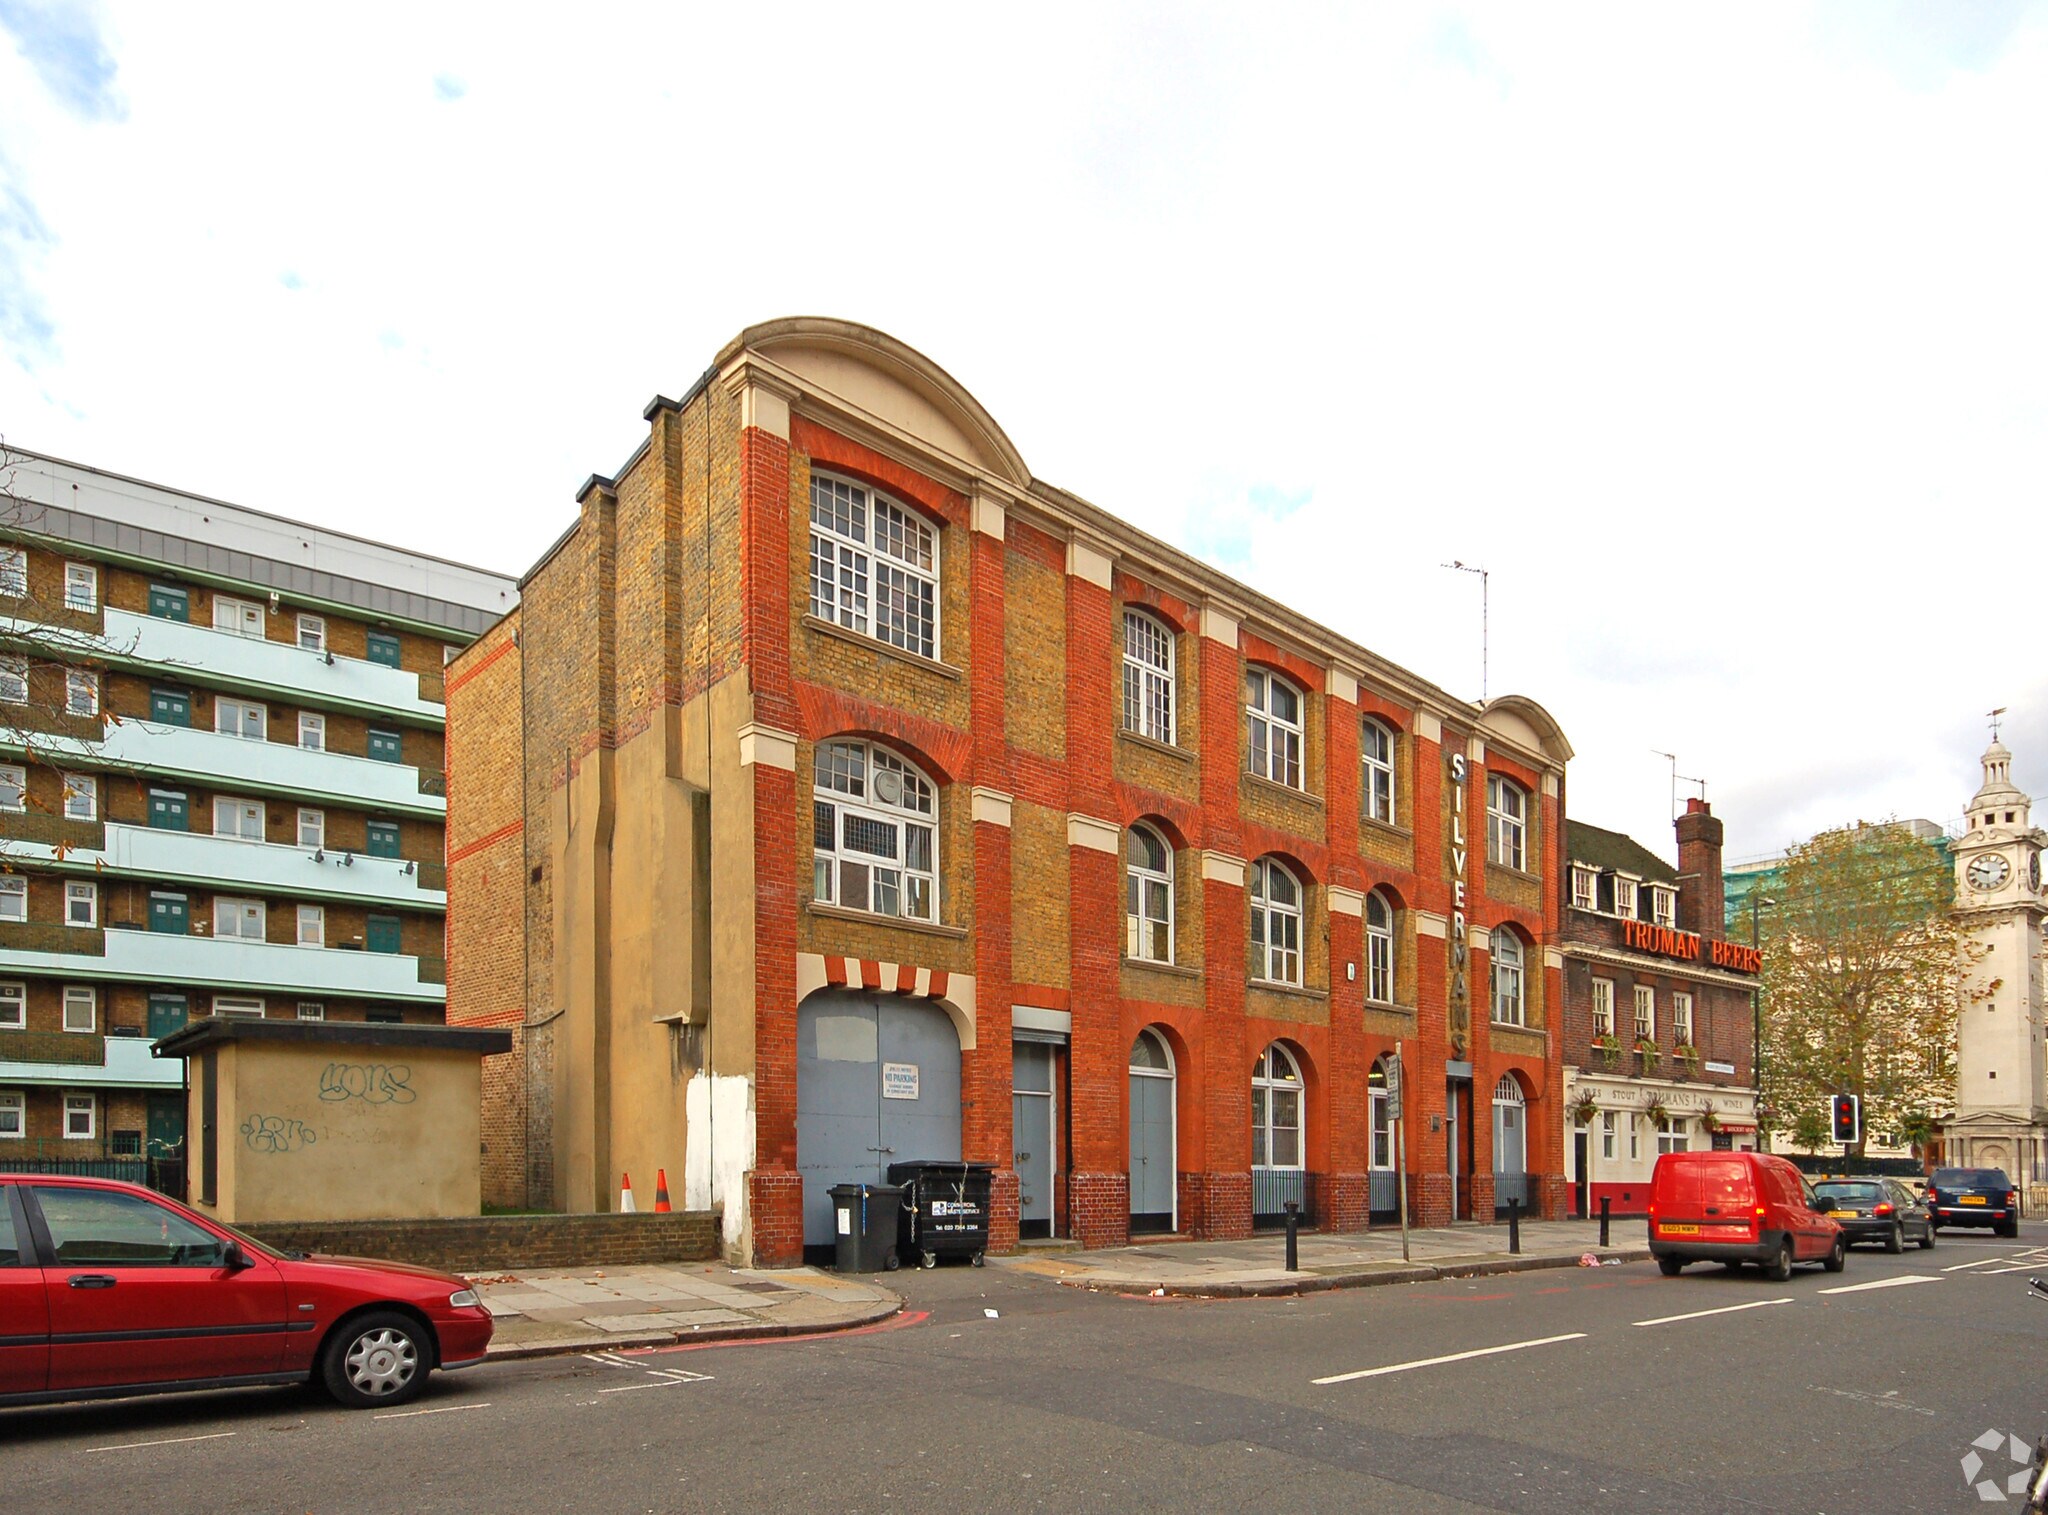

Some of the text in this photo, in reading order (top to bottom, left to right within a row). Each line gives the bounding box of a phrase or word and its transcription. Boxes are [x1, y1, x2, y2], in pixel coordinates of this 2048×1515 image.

[1622, 918, 1763, 972] TRUMAN BEERS
[893, 1073, 917, 1083] PARKING
[1612, 1089, 1635, 1100] STOUT
[1723, 1099, 1743, 1109] WINES
